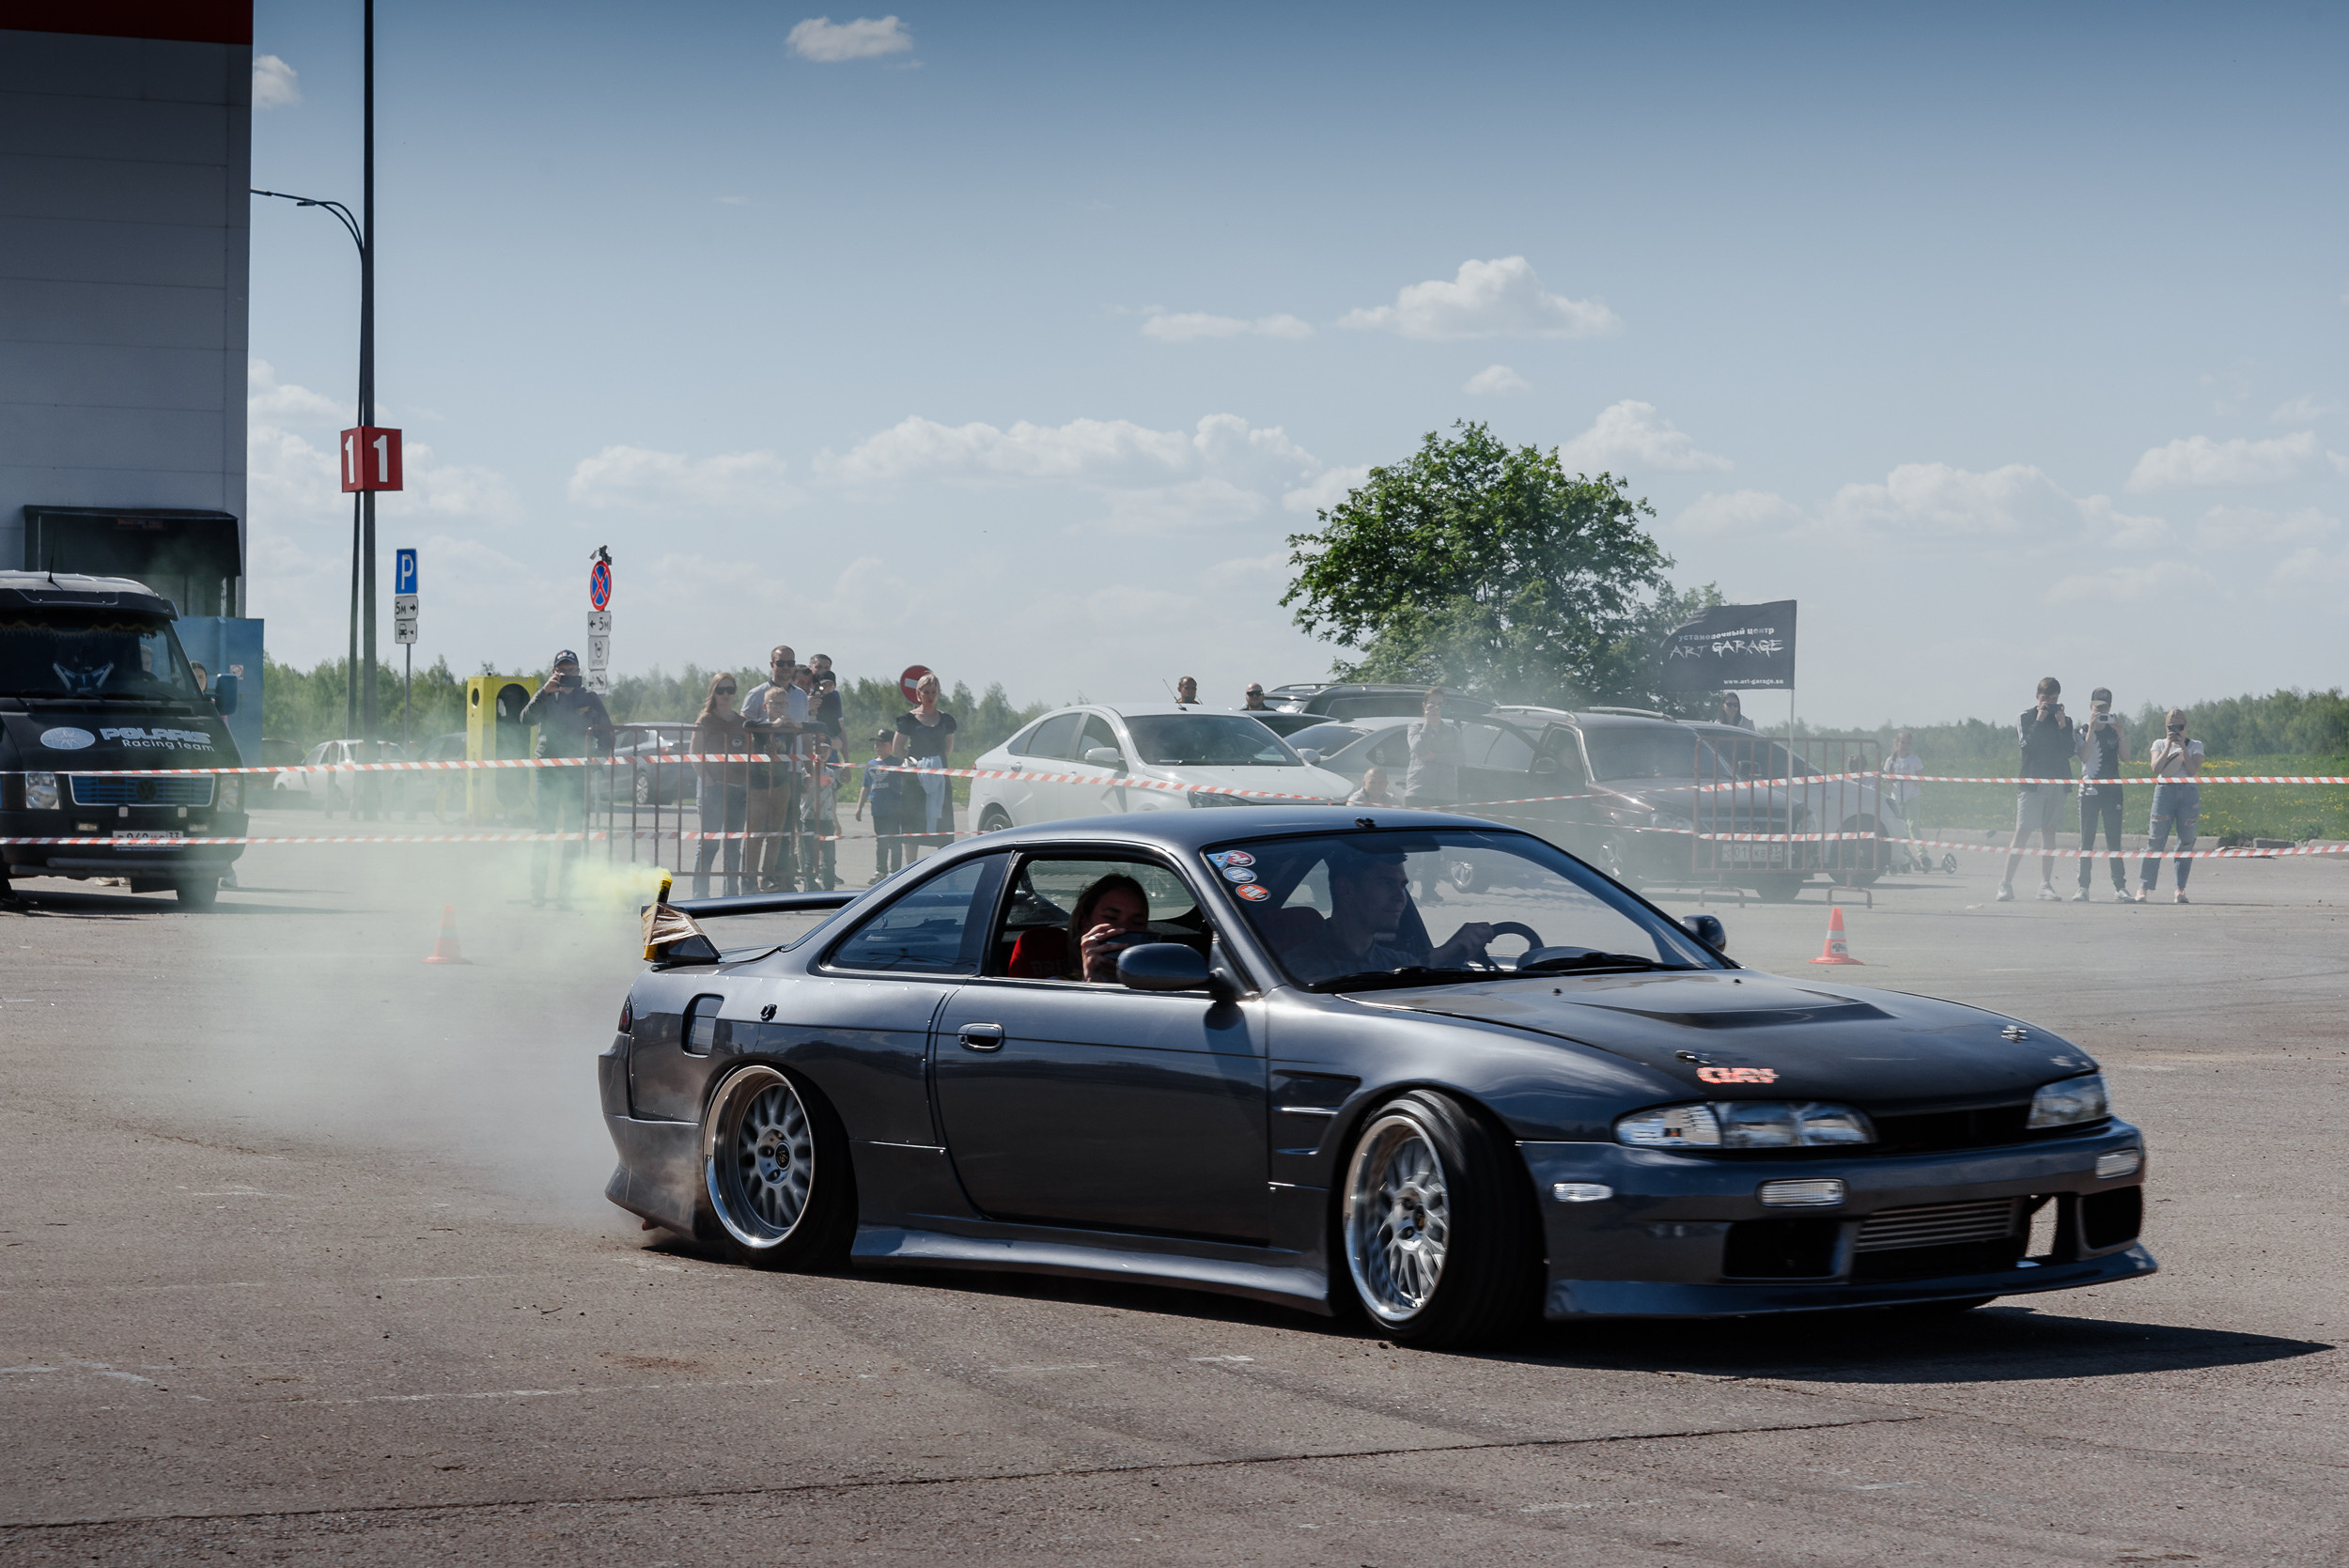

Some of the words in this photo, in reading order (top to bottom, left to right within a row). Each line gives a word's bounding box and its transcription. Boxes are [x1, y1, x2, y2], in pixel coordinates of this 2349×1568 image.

[401, 554, 414, 590] P
[1669, 644, 1709, 660] ART
[1711, 639, 1784, 658] GARAGE
[100, 727, 210, 744] POLARIS
[122, 739, 175, 751] Racing
[177, 741, 215, 752] team
